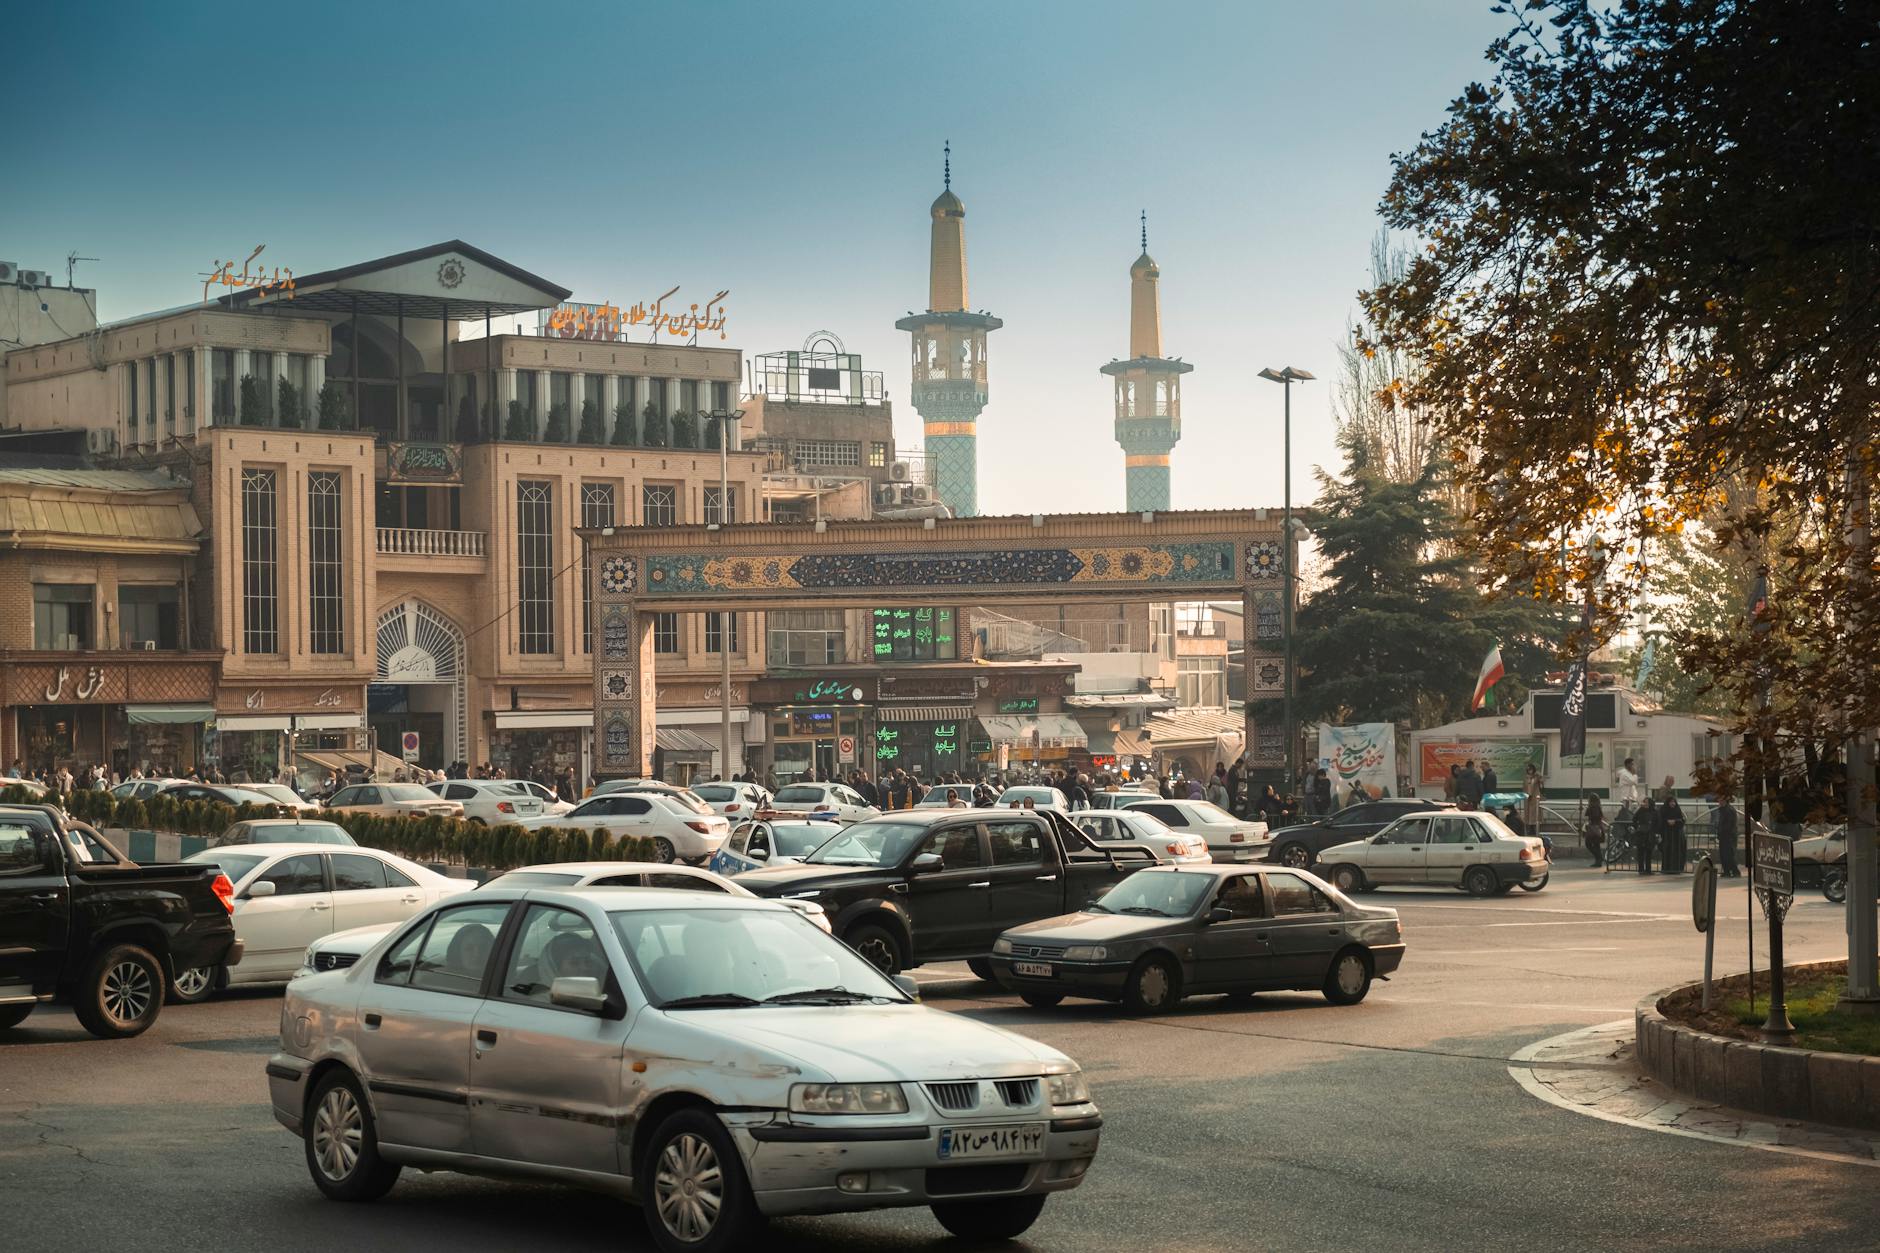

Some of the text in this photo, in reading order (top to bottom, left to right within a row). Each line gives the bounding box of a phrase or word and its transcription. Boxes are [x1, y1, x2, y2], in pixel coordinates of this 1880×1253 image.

[232, 244, 266, 298] بزرگ
[266, 266, 296, 300] بازار
[630, 300, 647, 326] طلا
[648, 285, 681, 331] مرکز
[893, 609, 910, 619] سیراب
[915, 607, 933, 621] کله
[915, 626, 933, 644] پاچه
[76, 666, 105, 699] فرش
[876, 726, 898, 741] سیراب
[934, 725, 956, 737] کله
[876, 744, 899, 759] شیردان
[934, 740, 956, 755] پاچه
[1330, 737, 1385, 779] هفته بسیج
[1756, 841, 1790, 865] میدان تجریش
